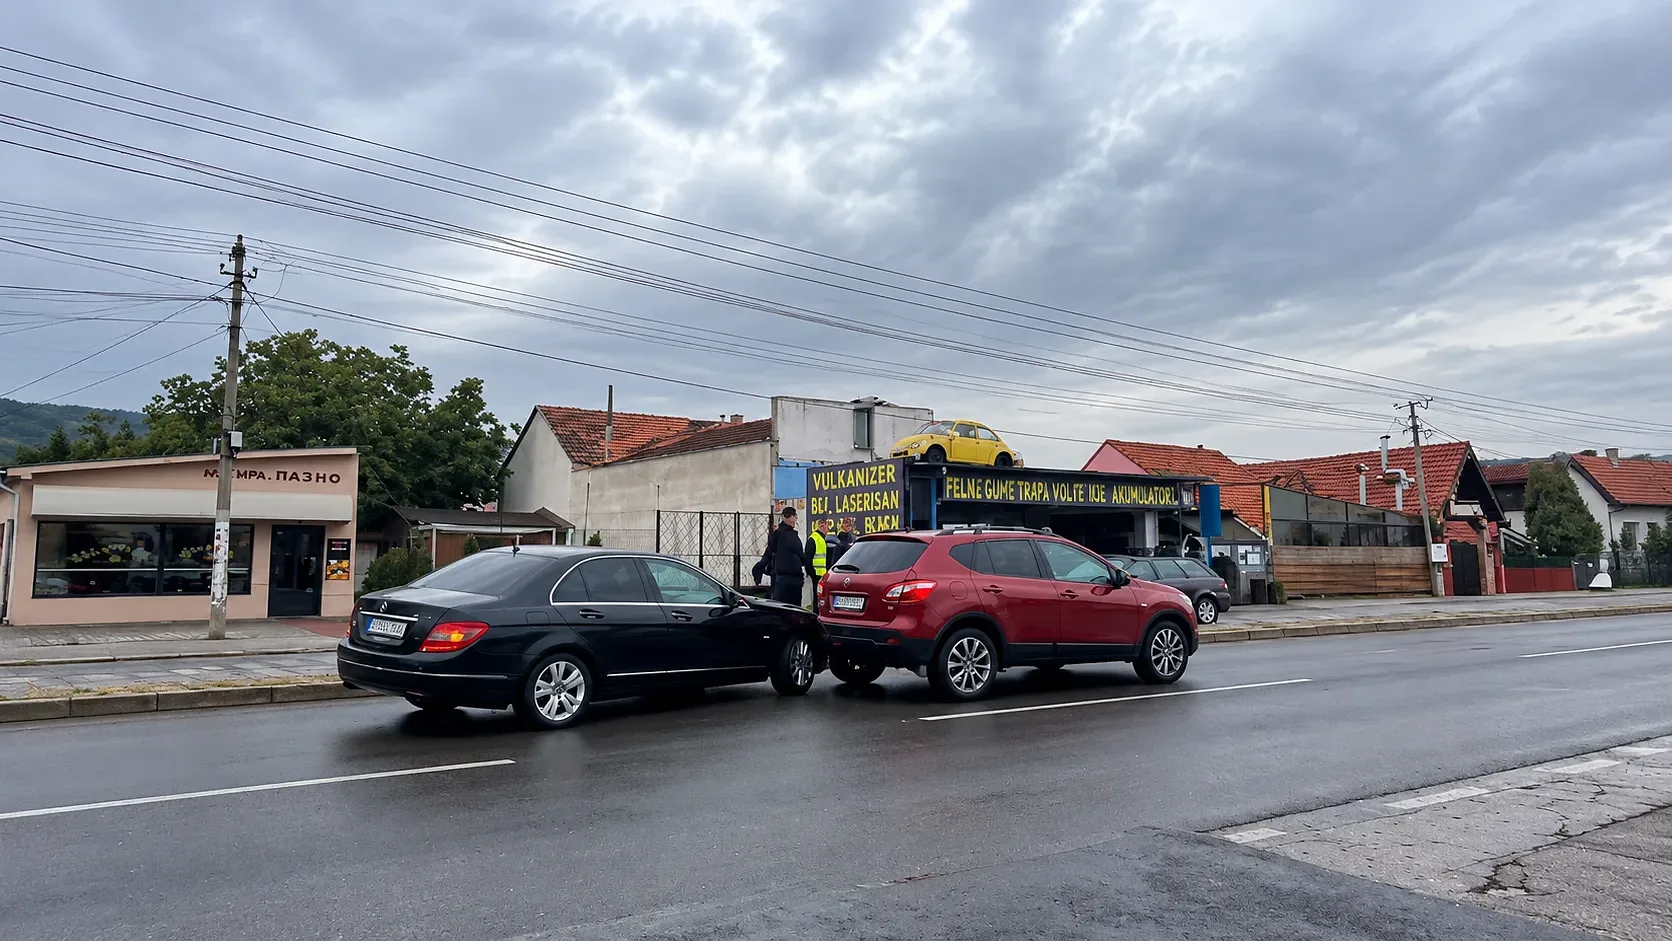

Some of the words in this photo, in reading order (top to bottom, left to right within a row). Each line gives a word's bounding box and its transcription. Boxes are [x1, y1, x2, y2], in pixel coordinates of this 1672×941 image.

[275, 470, 341, 484] ПАЗНО
[812, 463, 896, 491] VULKANIZER
[946, 476, 982, 499] FELNE
[985, 478, 1015, 501] GUME
[1017, 480, 1050, 502] TRAPA
[835, 490, 899, 513] LASERISAN
